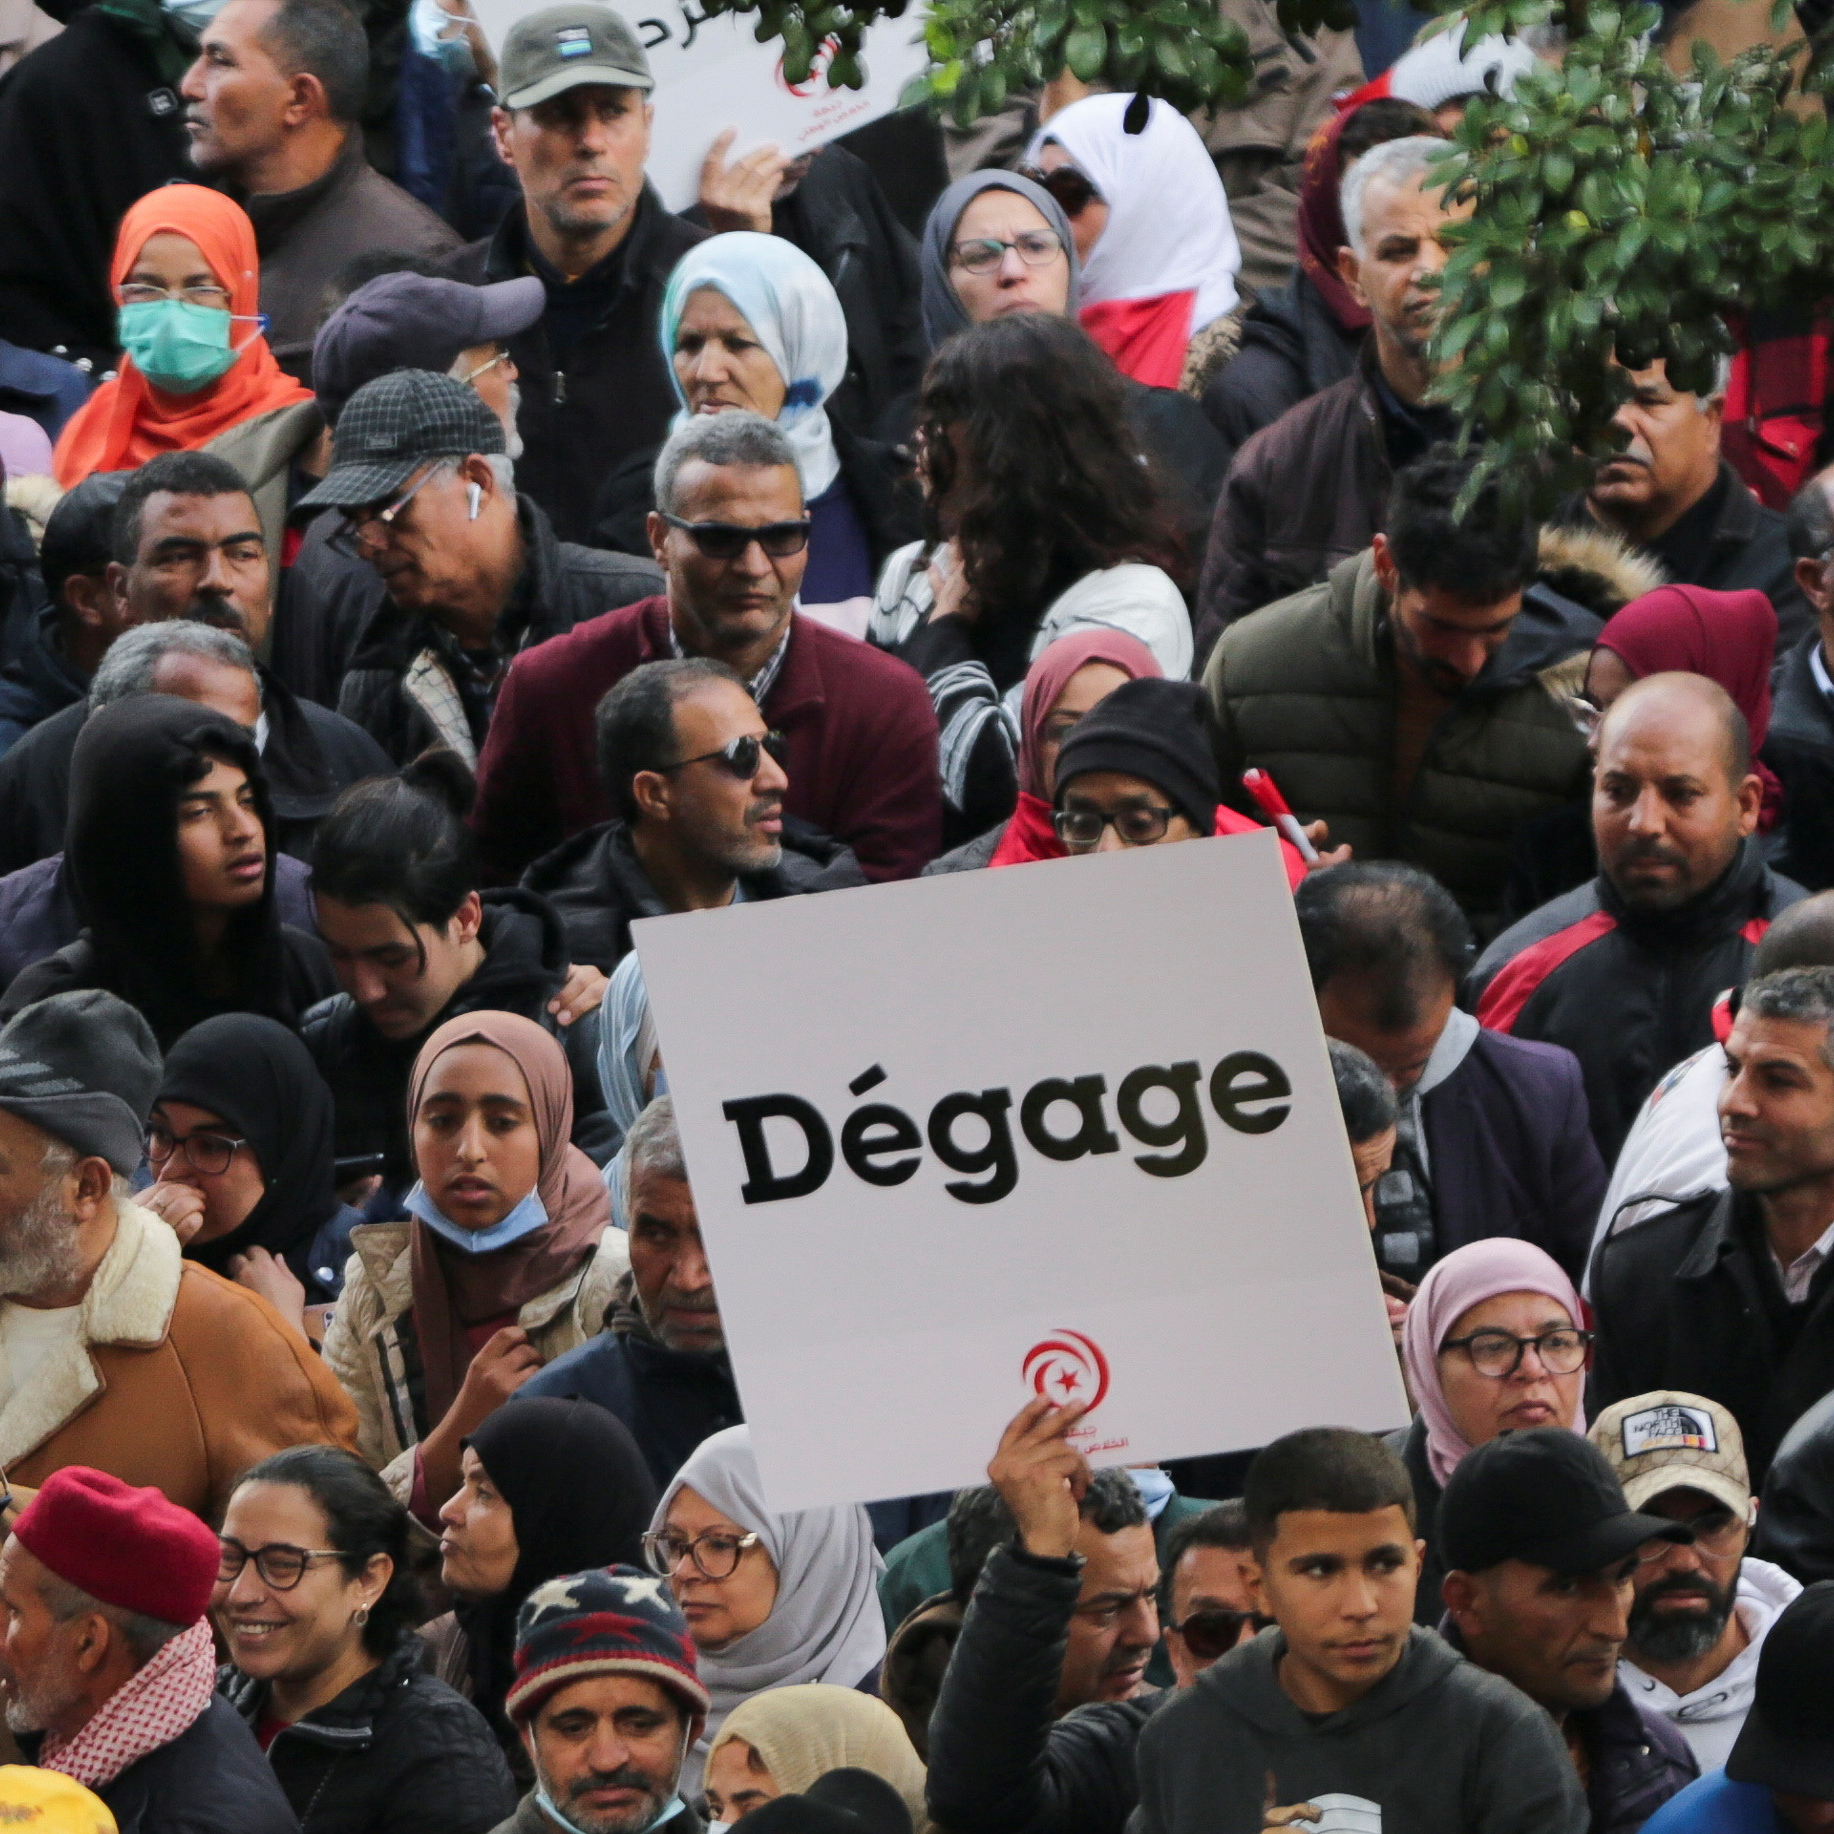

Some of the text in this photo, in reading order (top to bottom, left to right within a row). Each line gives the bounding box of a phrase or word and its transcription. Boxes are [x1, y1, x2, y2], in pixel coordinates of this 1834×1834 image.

[721, 1050, 1291, 1205] Dégage
[1653, 1407, 1681, 1419] THE
[1634, 1417, 1683, 1434] NORTH
